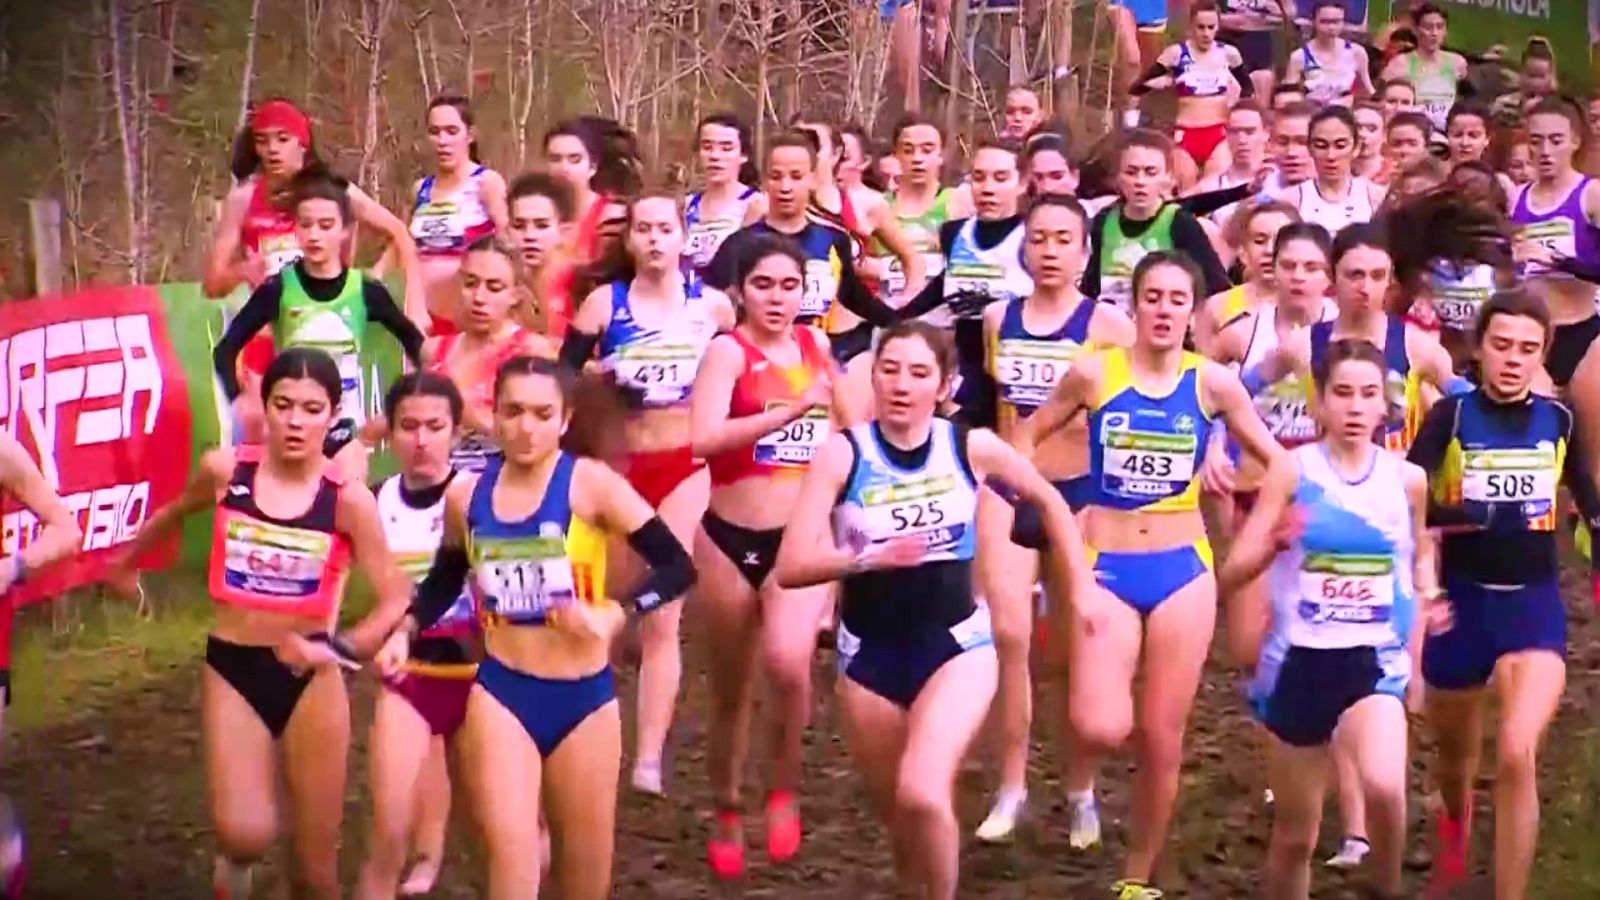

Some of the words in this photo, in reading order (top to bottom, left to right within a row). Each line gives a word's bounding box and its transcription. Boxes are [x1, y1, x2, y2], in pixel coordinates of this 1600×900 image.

[1010, 360, 1055, 383] 510
[776, 421, 815, 442] 503
[1122, 455, 1173, 477] 483
[1486, 474, 1535, 498] 508
[891, 500, 944, 531] 525
